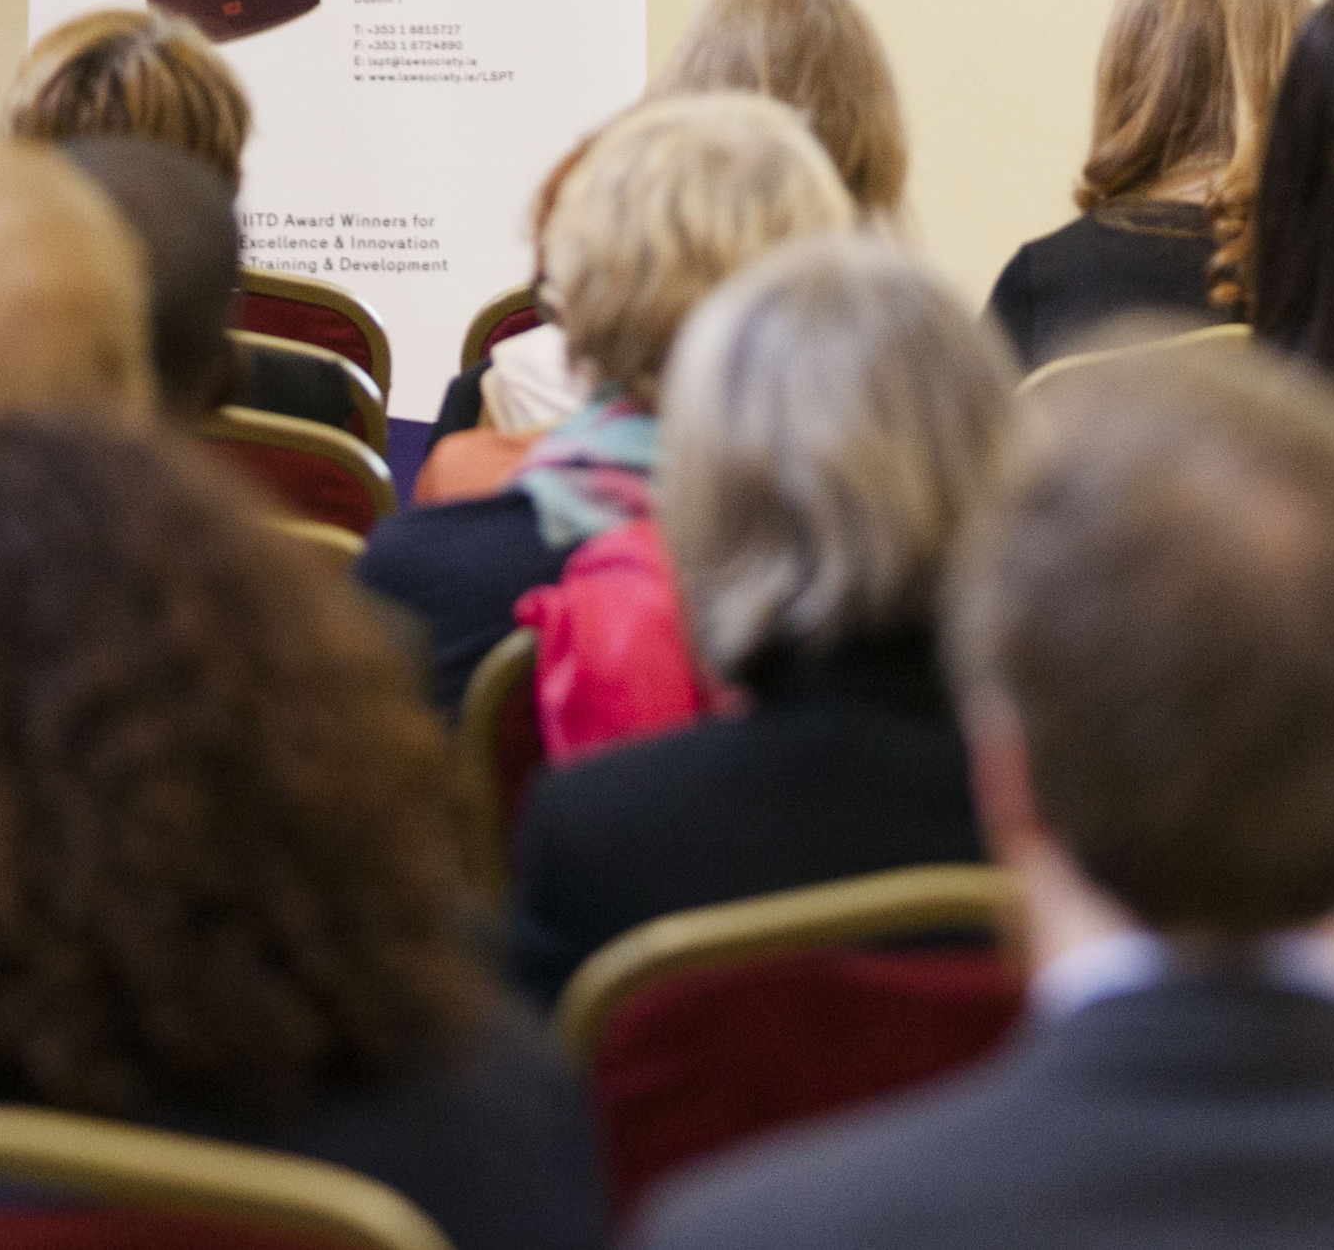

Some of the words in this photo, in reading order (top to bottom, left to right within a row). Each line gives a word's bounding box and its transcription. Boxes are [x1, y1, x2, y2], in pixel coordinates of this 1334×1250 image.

[284, 213, 335, 228] Award
[340, 213, 407, 228] Winners
[412, 213, 435, 228] for
[239, 235, 328, 250] Excellence
[333, 235, 344, 250] &
[350, 235, 440, 250] Innovation
[249, 256, 318, 274] Training
[323, 257, 334, 272] &
[339, 256, 448, 274] Development
